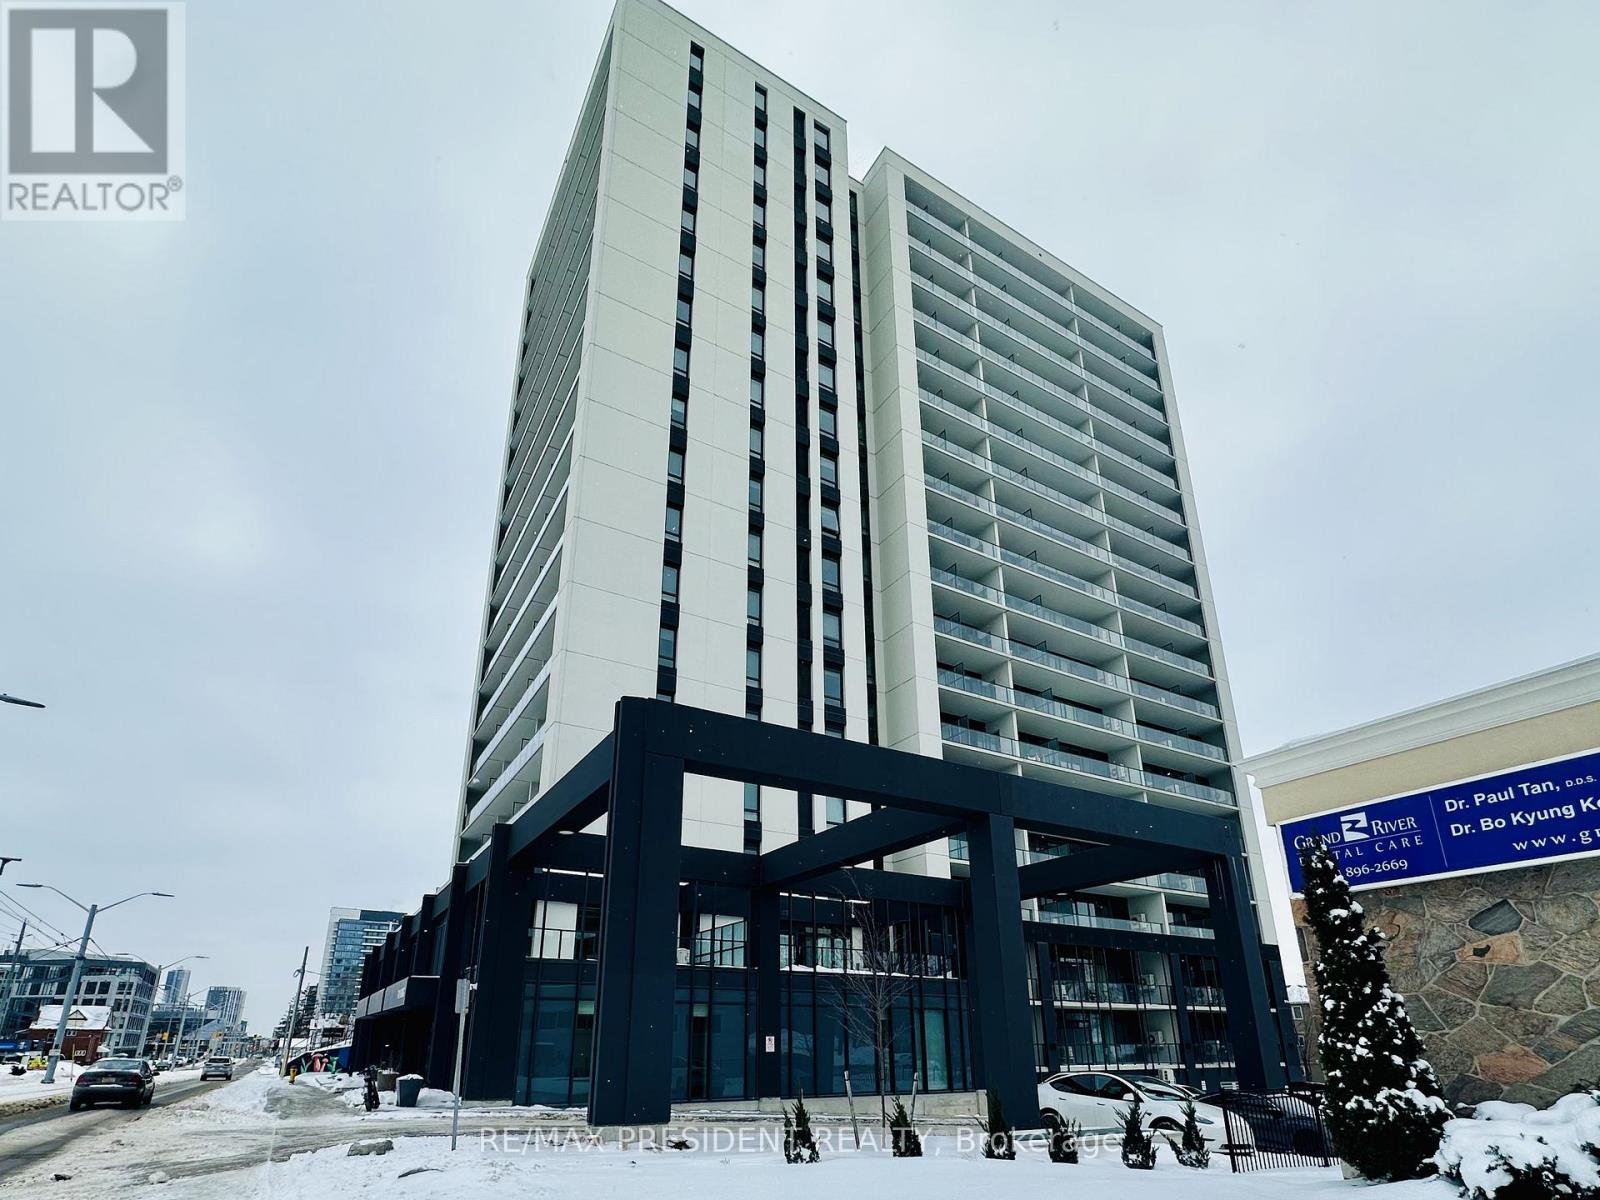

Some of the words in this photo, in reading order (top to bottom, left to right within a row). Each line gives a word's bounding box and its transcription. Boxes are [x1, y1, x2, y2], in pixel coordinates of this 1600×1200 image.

[1444, 799, 1470, 812] Dr.
[1473, 786, 1515, 806] Paul
[1518, 780, 1560, 797] Tan,
[1294, 832, 1341, 850] GRND
[1371, 816, 1418, 836] RIVER
[1450, 822, 1476, 837] Dr.
[1480, 817, 1506, 831] Bo
[1510, 804, 1575, 826] Kyung
[1375, 835, 1424, 853] CARE
[1345, 859, 1409, 878] 896-2669
